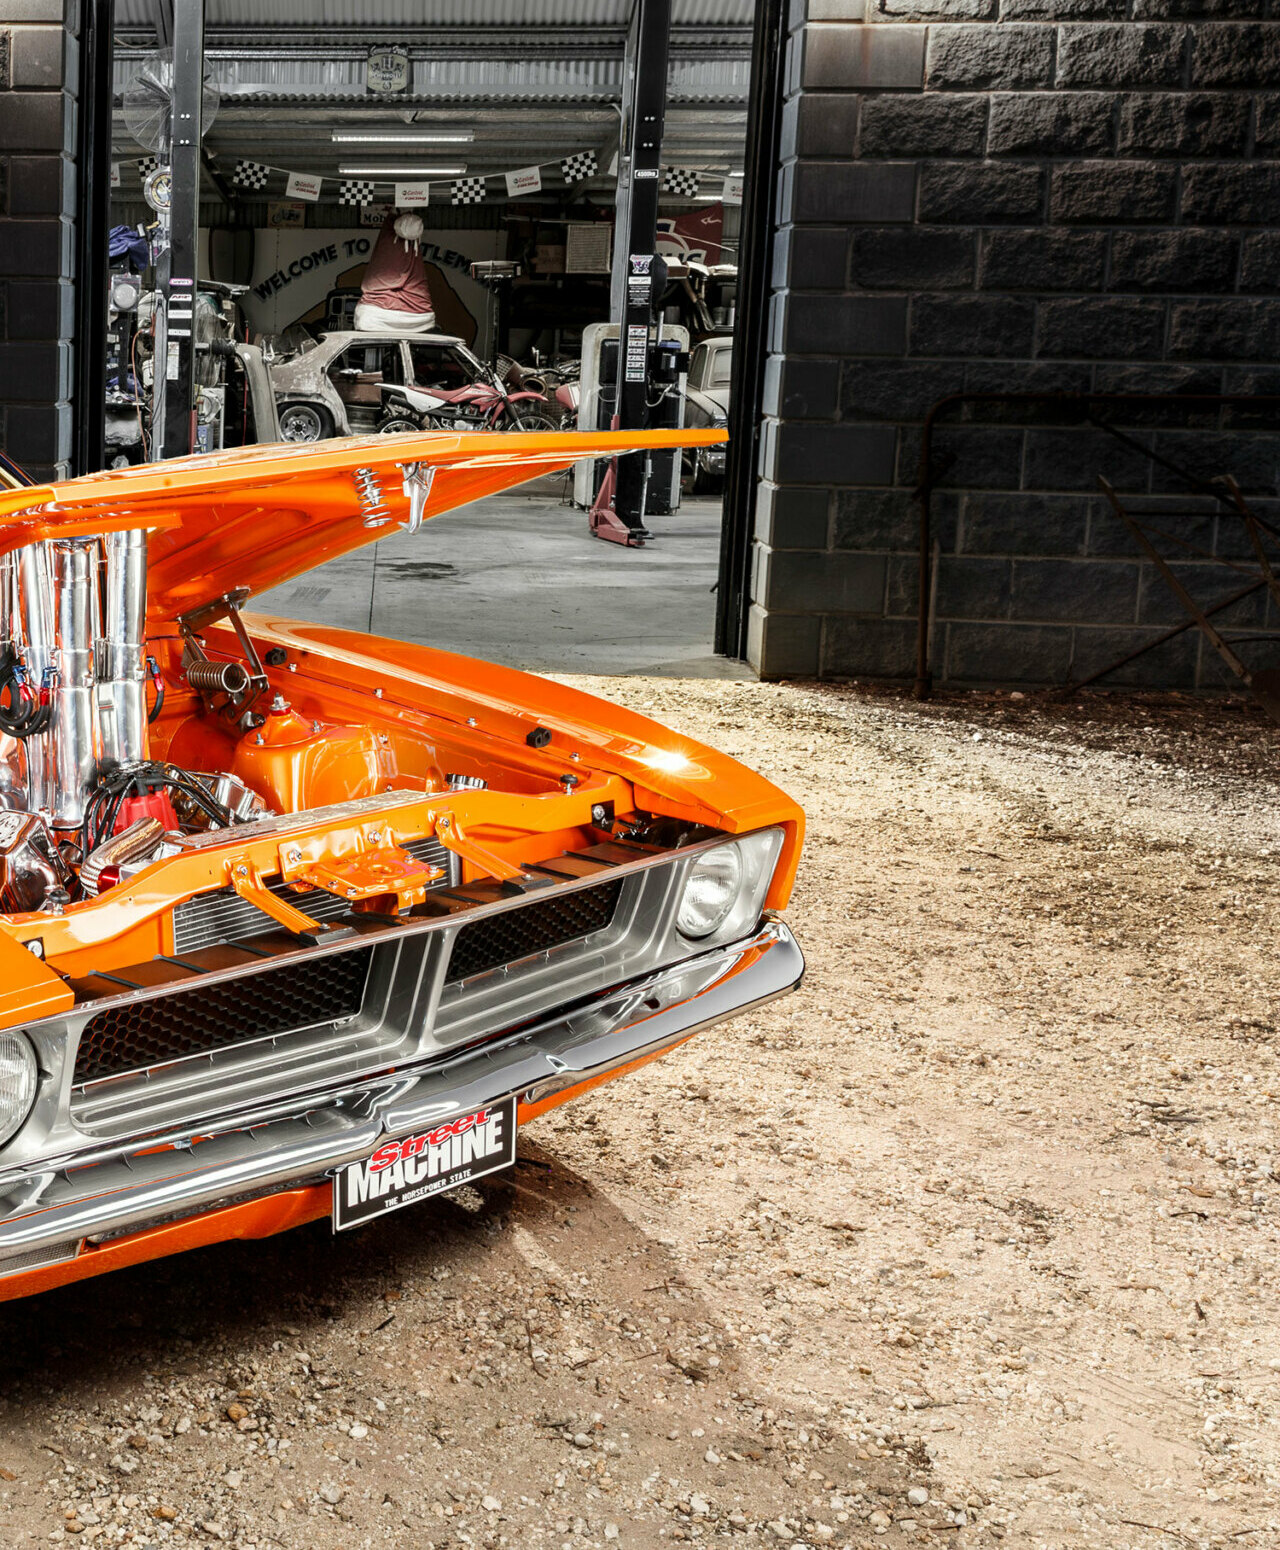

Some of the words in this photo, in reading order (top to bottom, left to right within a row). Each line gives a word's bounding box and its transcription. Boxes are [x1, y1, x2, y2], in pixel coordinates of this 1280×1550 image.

[253, 244, 338, 302] WELCOME
[342, 238, 371, 258] TO
[347, 1111, 504, 1208] MACHINE
[369, 1107, 492, 1173] Street
[385, 1197, 399, 1208] THE
[402, 1178, 447, 1201] HORSEPOWER
[450, 1169, 472, 1185] STATE
